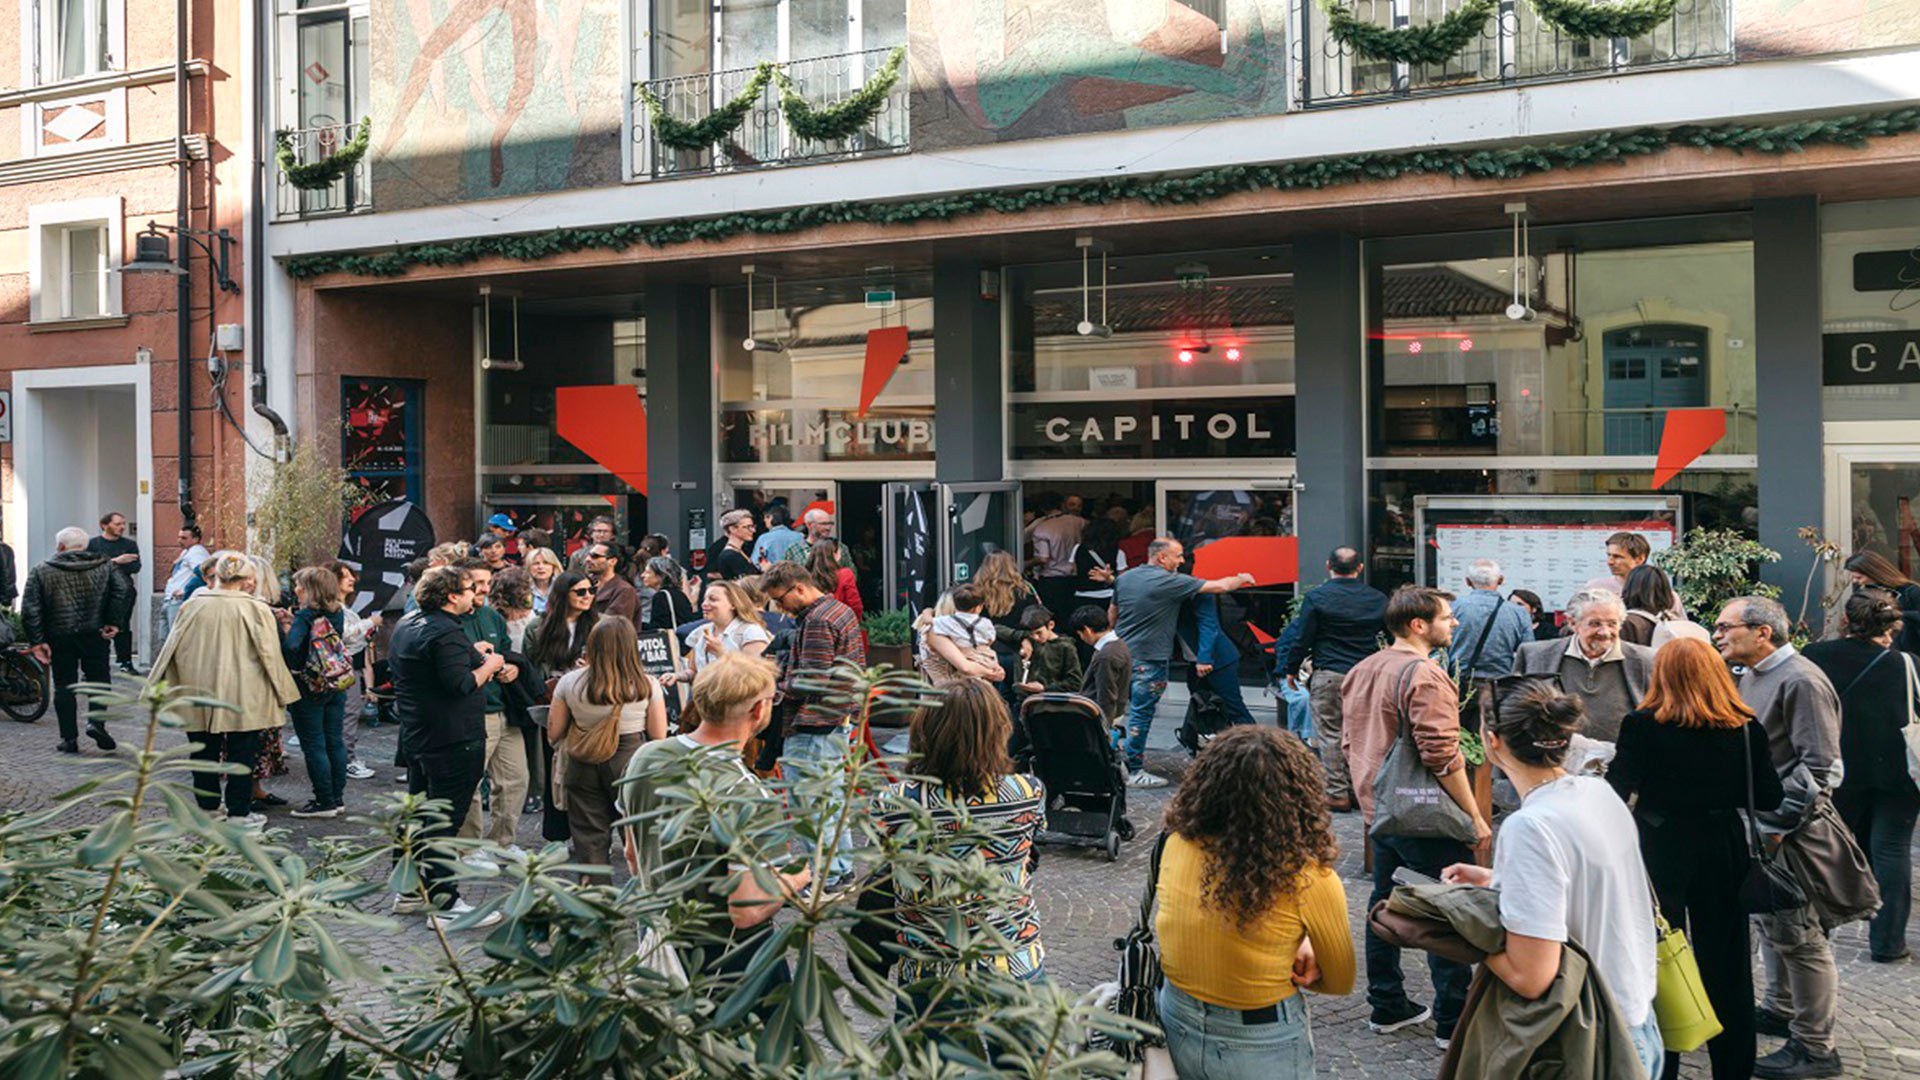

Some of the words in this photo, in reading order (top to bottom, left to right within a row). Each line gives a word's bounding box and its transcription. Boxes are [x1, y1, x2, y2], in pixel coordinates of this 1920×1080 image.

[1851, 341, 1920, 372] CA
[749, 420, 930, 446] FILMCLUB
[1045, 413, 1271, 442] CAPITOL
[384, 547, 416, 555] FESTIVAL
[647, 650, 668, 662] BAR
